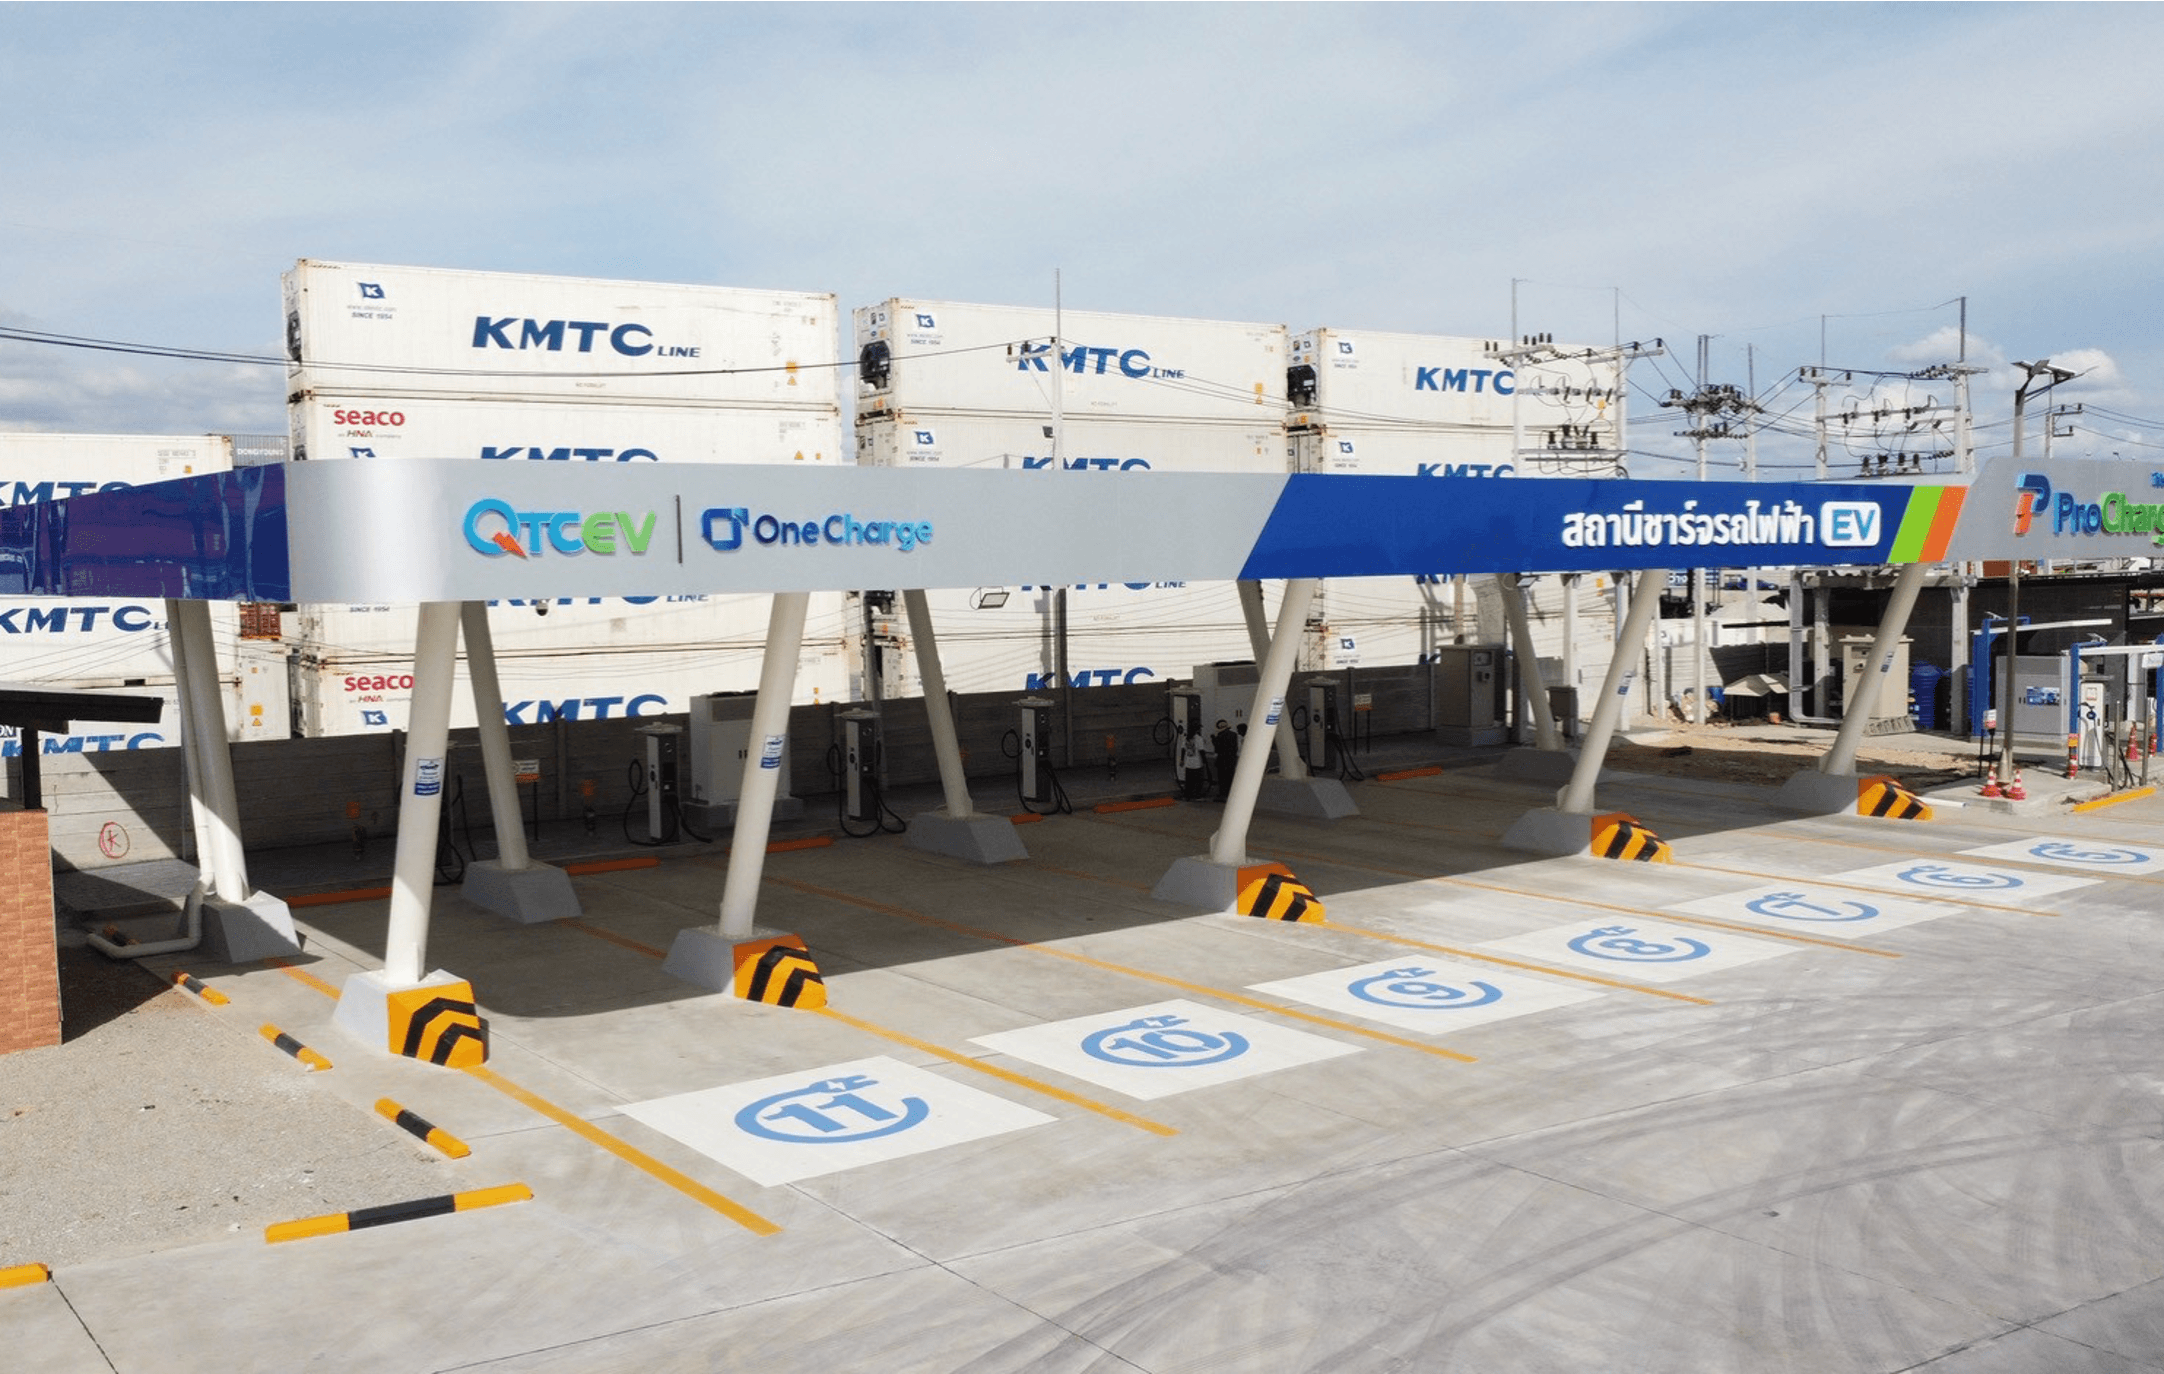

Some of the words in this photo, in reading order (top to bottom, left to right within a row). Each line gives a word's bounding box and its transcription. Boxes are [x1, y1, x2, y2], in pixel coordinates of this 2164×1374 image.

[472, 316, 653, 357] KMTC
[657, 346, 701, 358] LINE
[1018, 344, 1151, 378] KMTC
[1153, 368, 1185, 379] LINE
[1415, 366, 1515, 396] KMTC
[333, 410, 406, 426] seaco
[0, 481, 133, 506] MT
[463, 498, 656, 559] QTCEV
[1562, 499, 1815, 547] สถานีชาร์จรถไฟฟ้า
[1832, 509, 1875, 541] EV
[344, 675, 414, 692] seaco
[1597, 937, 1677, 956] 8
[1386, 981, 1467, 1001] 9
[1107, 1029, 1227, 1060] 10
[763, 1092, 900, 1133] 11
